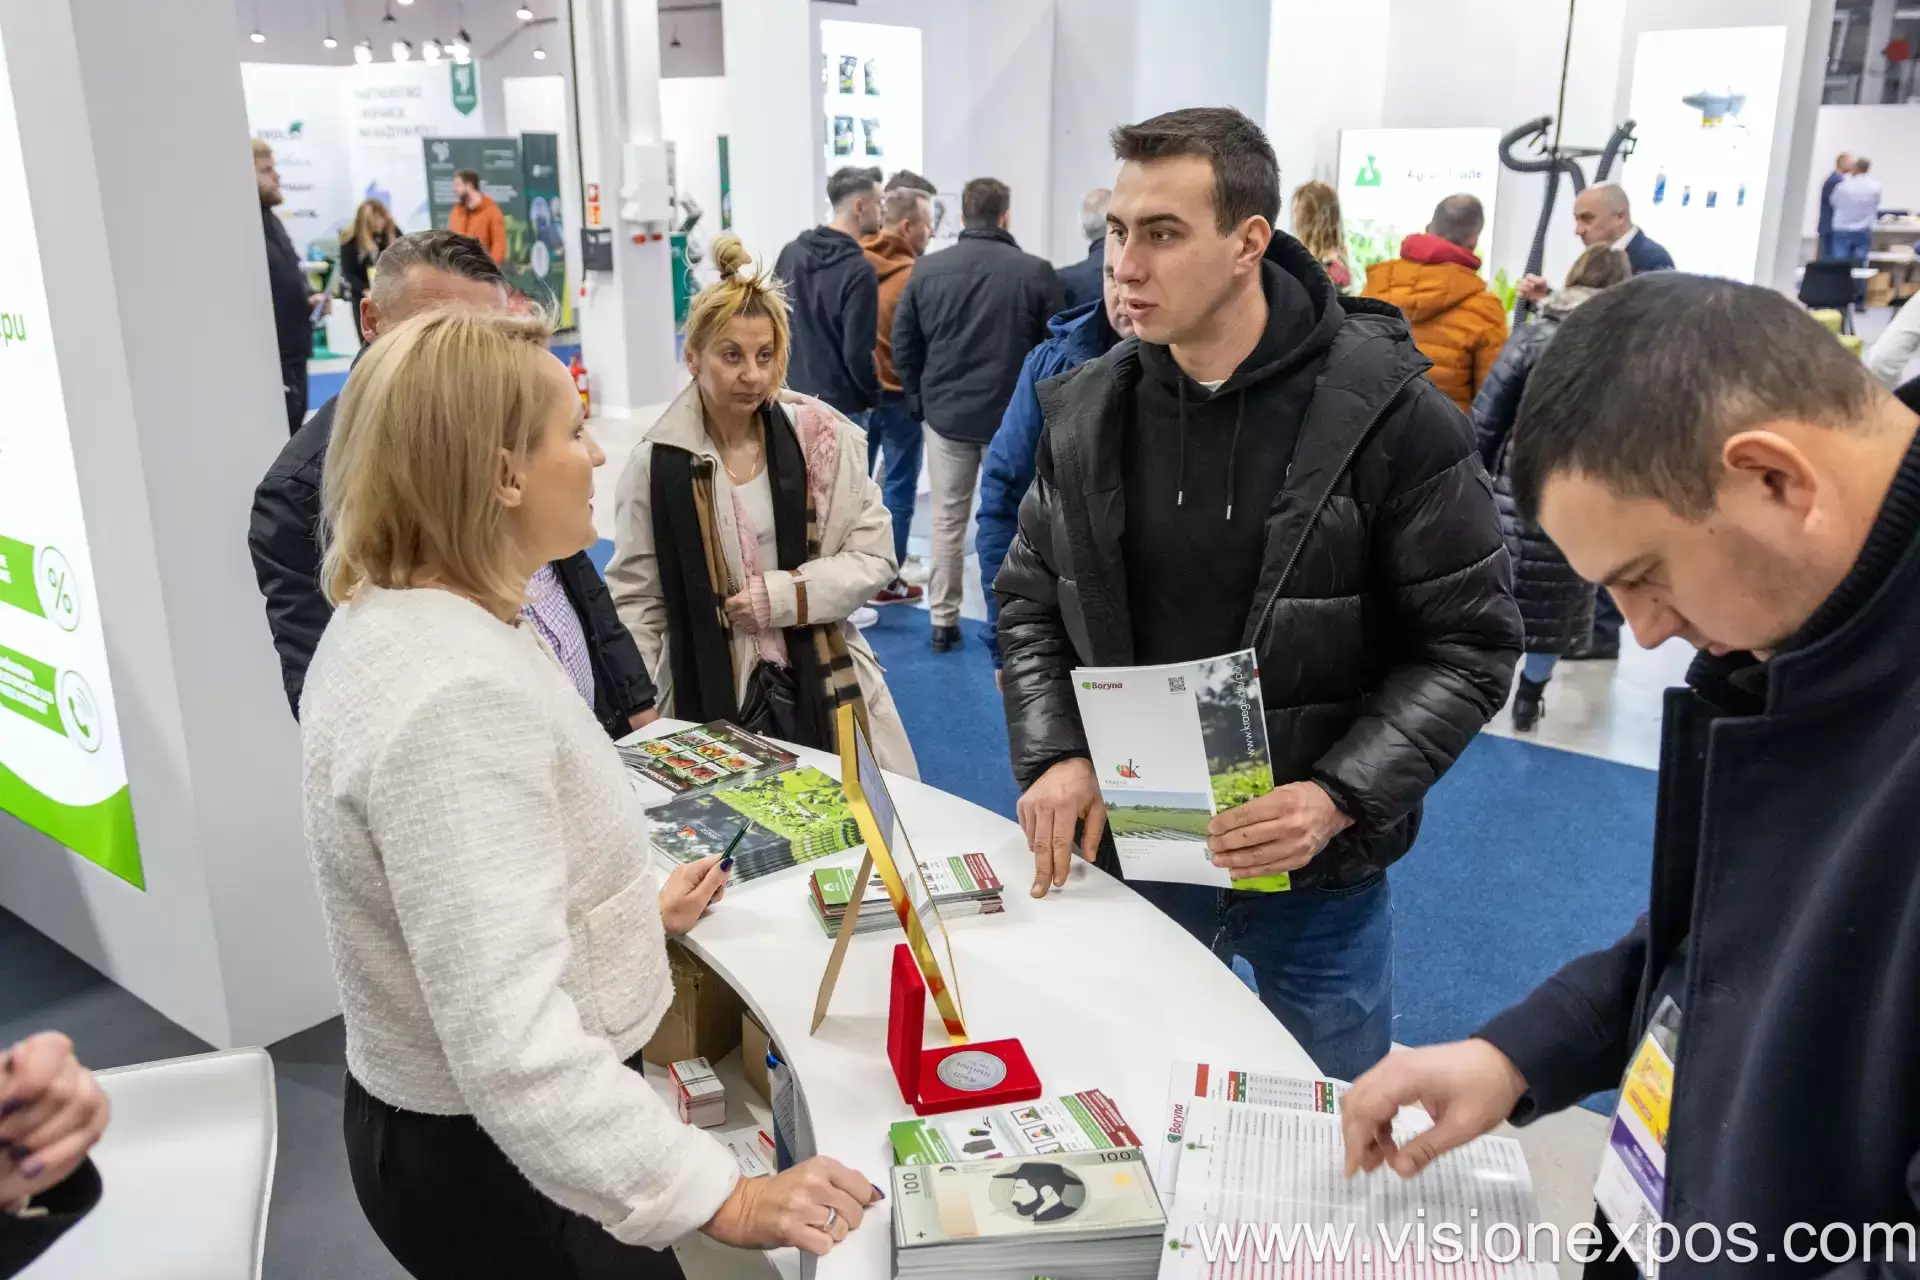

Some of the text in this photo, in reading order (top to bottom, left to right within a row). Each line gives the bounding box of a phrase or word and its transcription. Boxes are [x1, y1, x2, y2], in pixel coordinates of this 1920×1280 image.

[0, 313, 26, 348] pu
[1091, 681, 1123, 690] Boryna
[1168, 1103, 1184, 1135] Boryna
[1099, 1151, 1131, 1162] 100
[902, 1172, 921, 1195] 100
